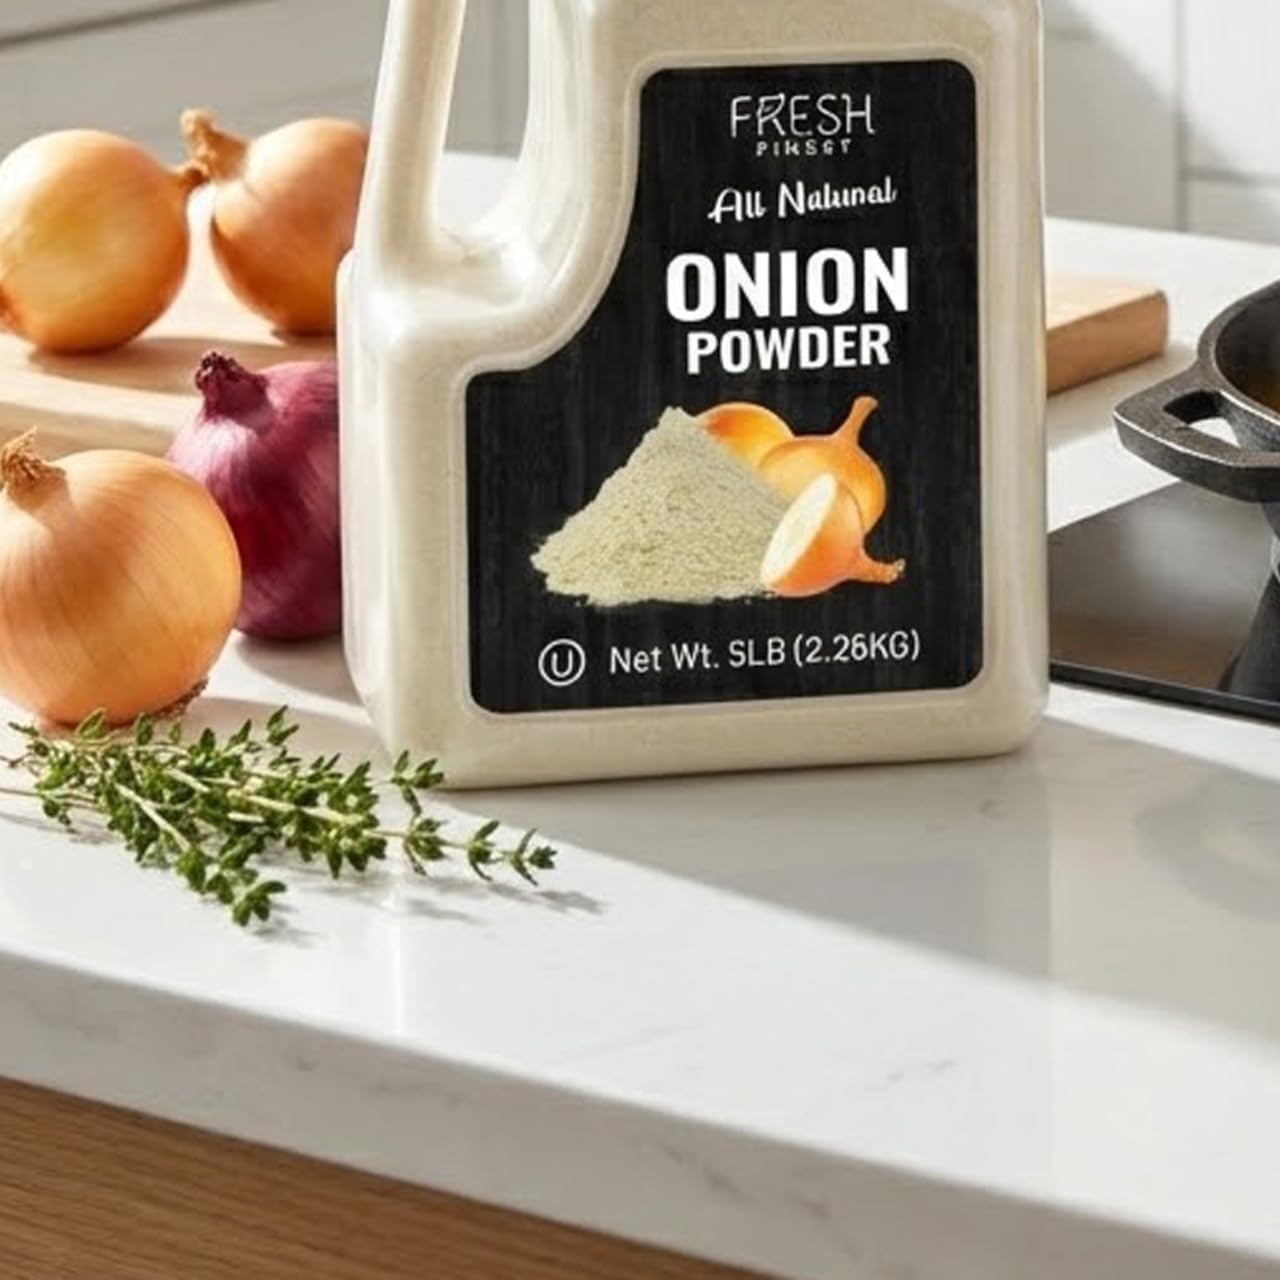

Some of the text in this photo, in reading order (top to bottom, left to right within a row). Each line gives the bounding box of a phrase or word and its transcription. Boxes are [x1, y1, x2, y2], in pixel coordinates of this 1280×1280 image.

[730, 92, 875, 137] FRESH
[707, 188, 766, 224] All
[666, 246, 909, 322] ONION
[686, 323, 891, 375] POWDER
[610, 646, 662, 674] Net
[670, 642, 719, 670] Wt.
[793, 628, 920, 668] (2.26KG)
